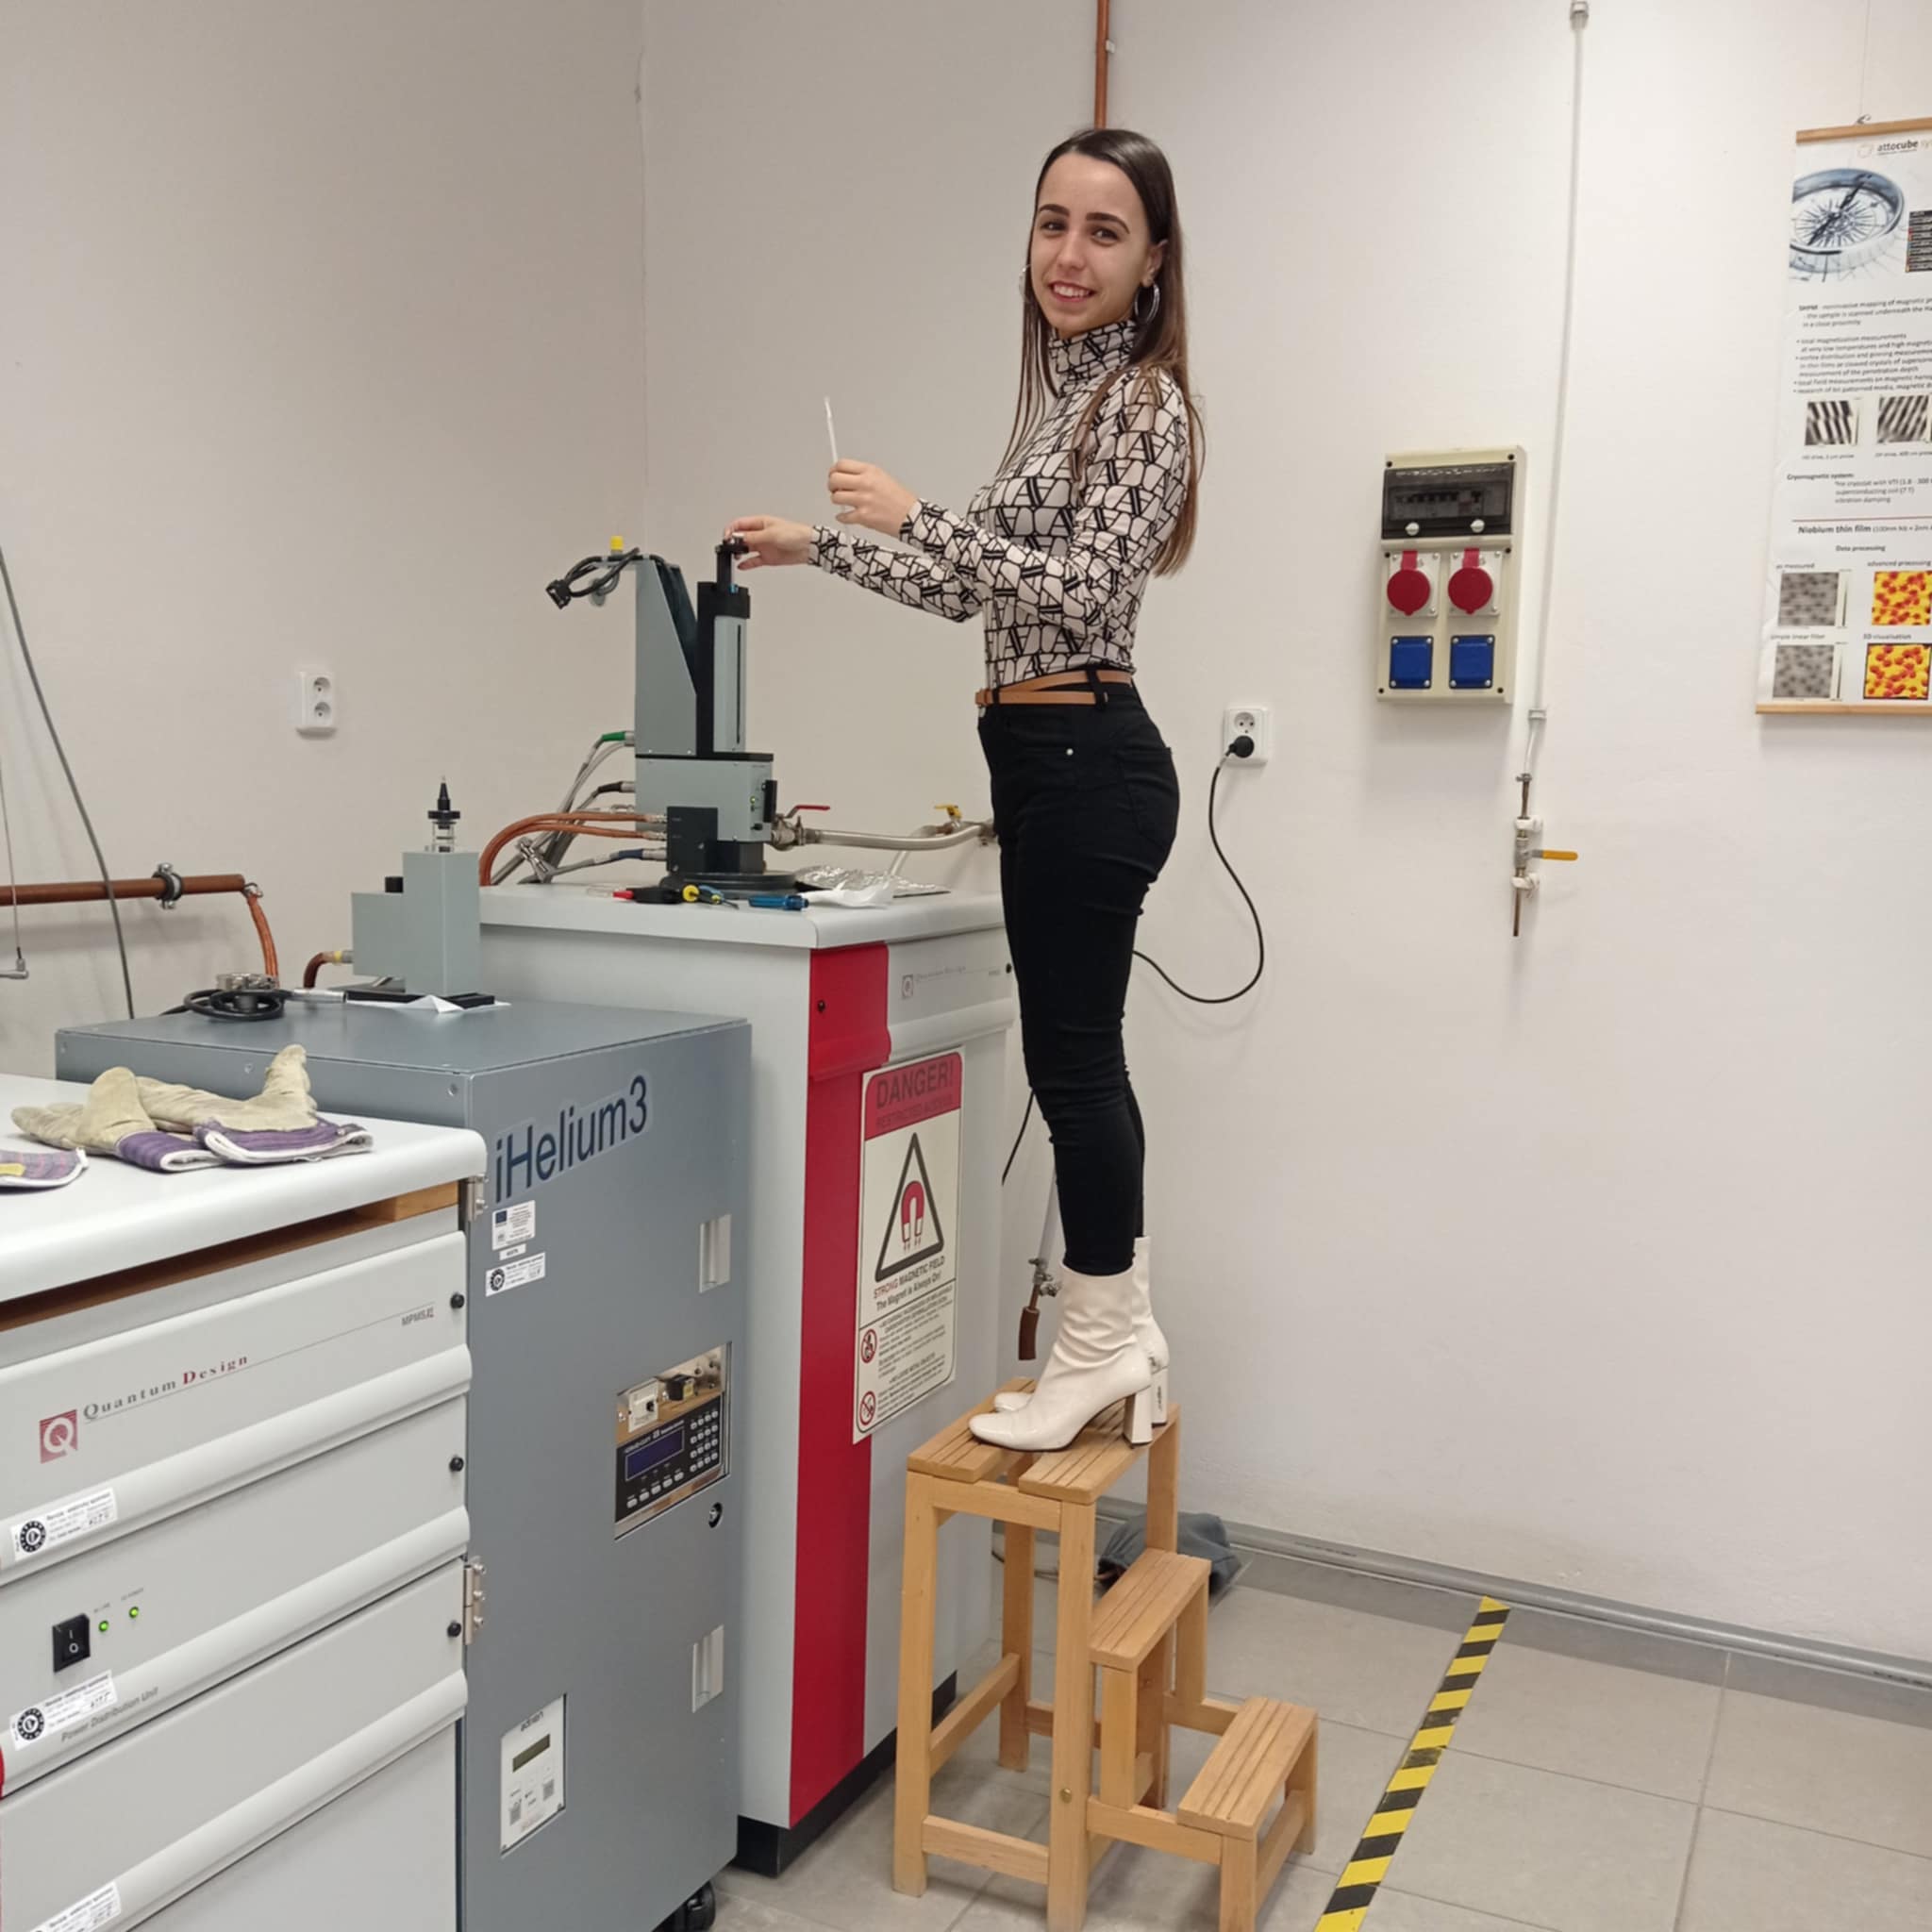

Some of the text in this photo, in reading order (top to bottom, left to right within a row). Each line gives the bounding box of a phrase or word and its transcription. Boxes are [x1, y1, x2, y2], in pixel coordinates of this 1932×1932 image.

[1877, 141, 1918, 152] attocube
[876, 1060, 954, 1109] DANGER!
[495, 1074, 647, 1204] iHelium3
[84, 1356, 248, 1421] Quantum Design
